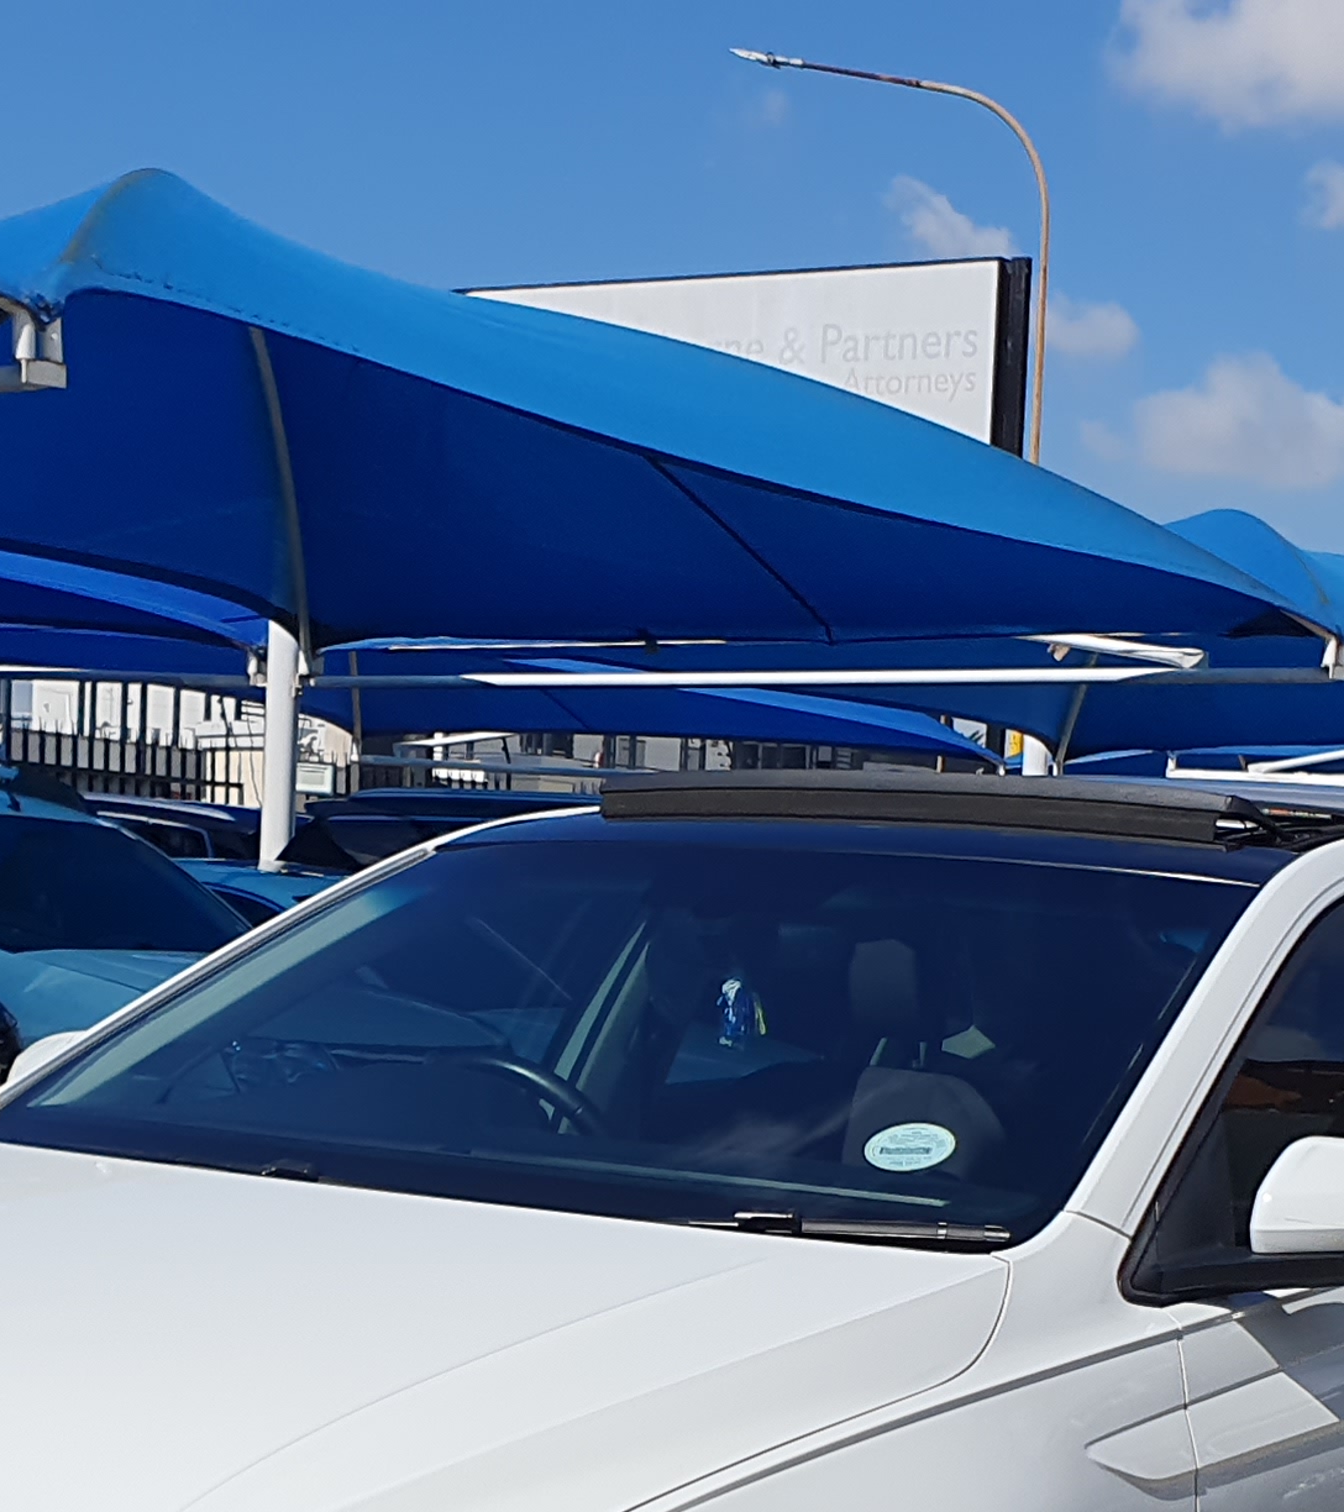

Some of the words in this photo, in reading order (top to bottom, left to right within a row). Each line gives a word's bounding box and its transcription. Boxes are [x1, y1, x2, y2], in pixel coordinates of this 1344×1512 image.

[777, 326, 806, 366] &
[820, 323, 978, 364] Partners
[845, 368, 977, 402] Attorneys
